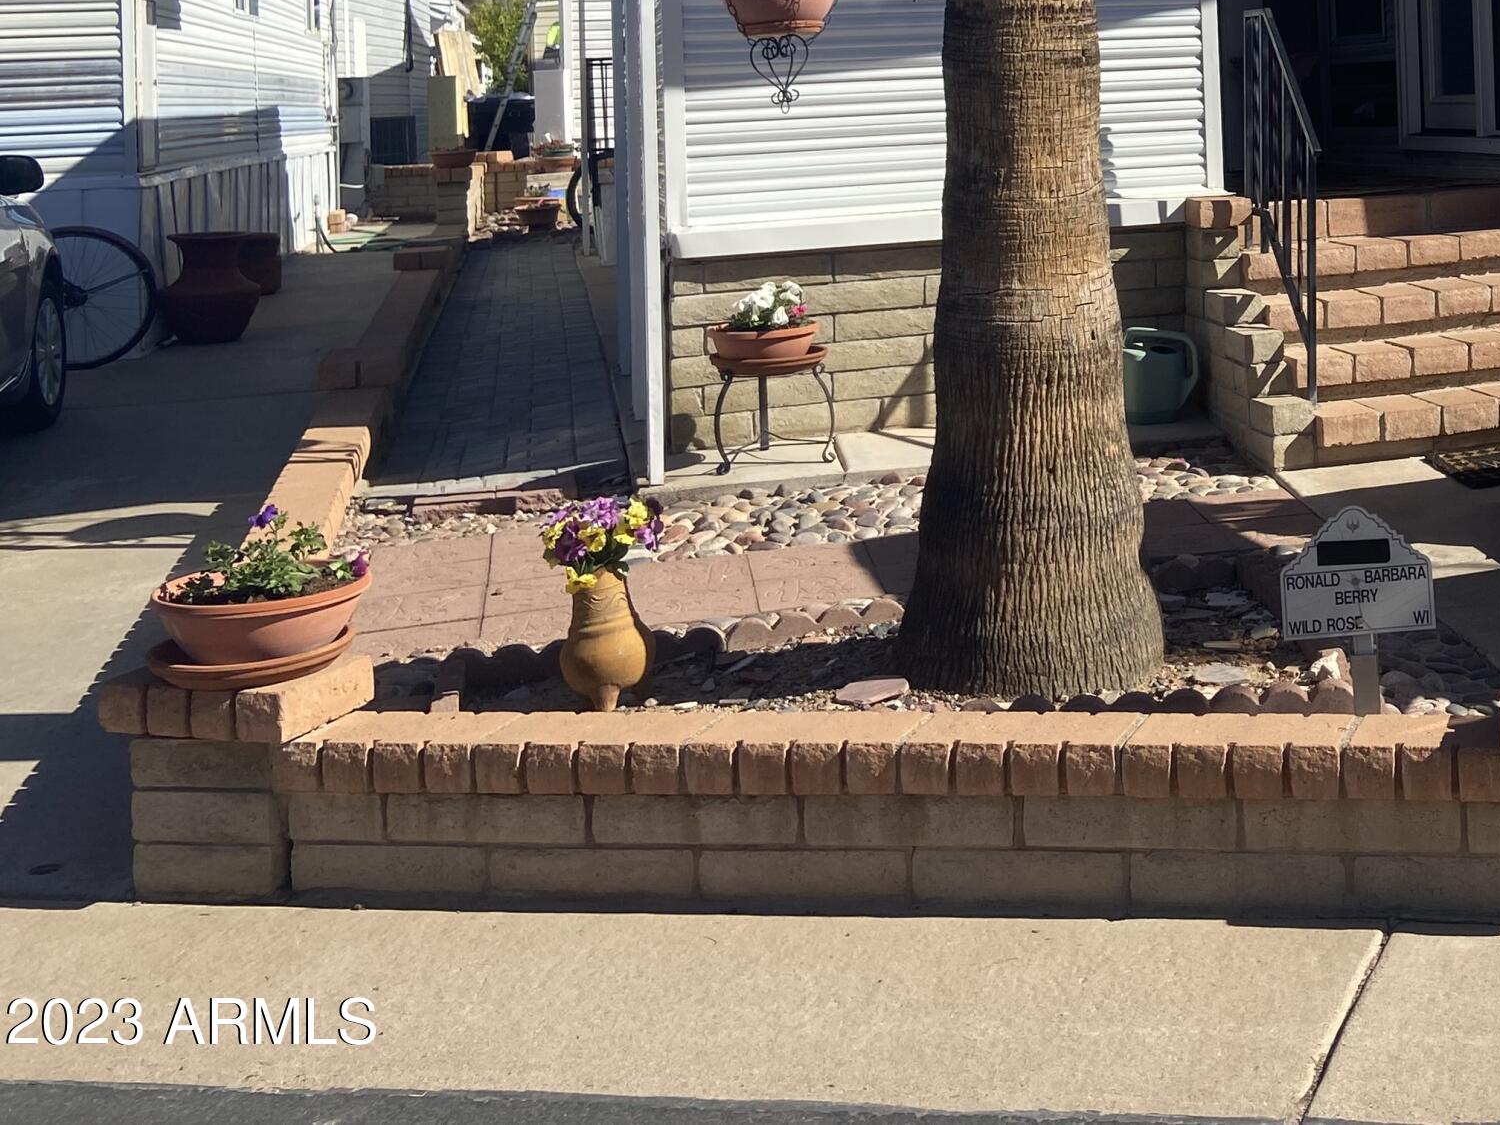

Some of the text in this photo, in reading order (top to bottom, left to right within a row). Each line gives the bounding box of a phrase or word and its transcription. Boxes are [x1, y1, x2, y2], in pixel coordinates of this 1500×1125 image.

[1286, 566, 1426, 591] RONALD BARBARA
[1335, 588, 1378, 605] BERRY
[1288, 610, 1430, 636] WILD ROSE WI
